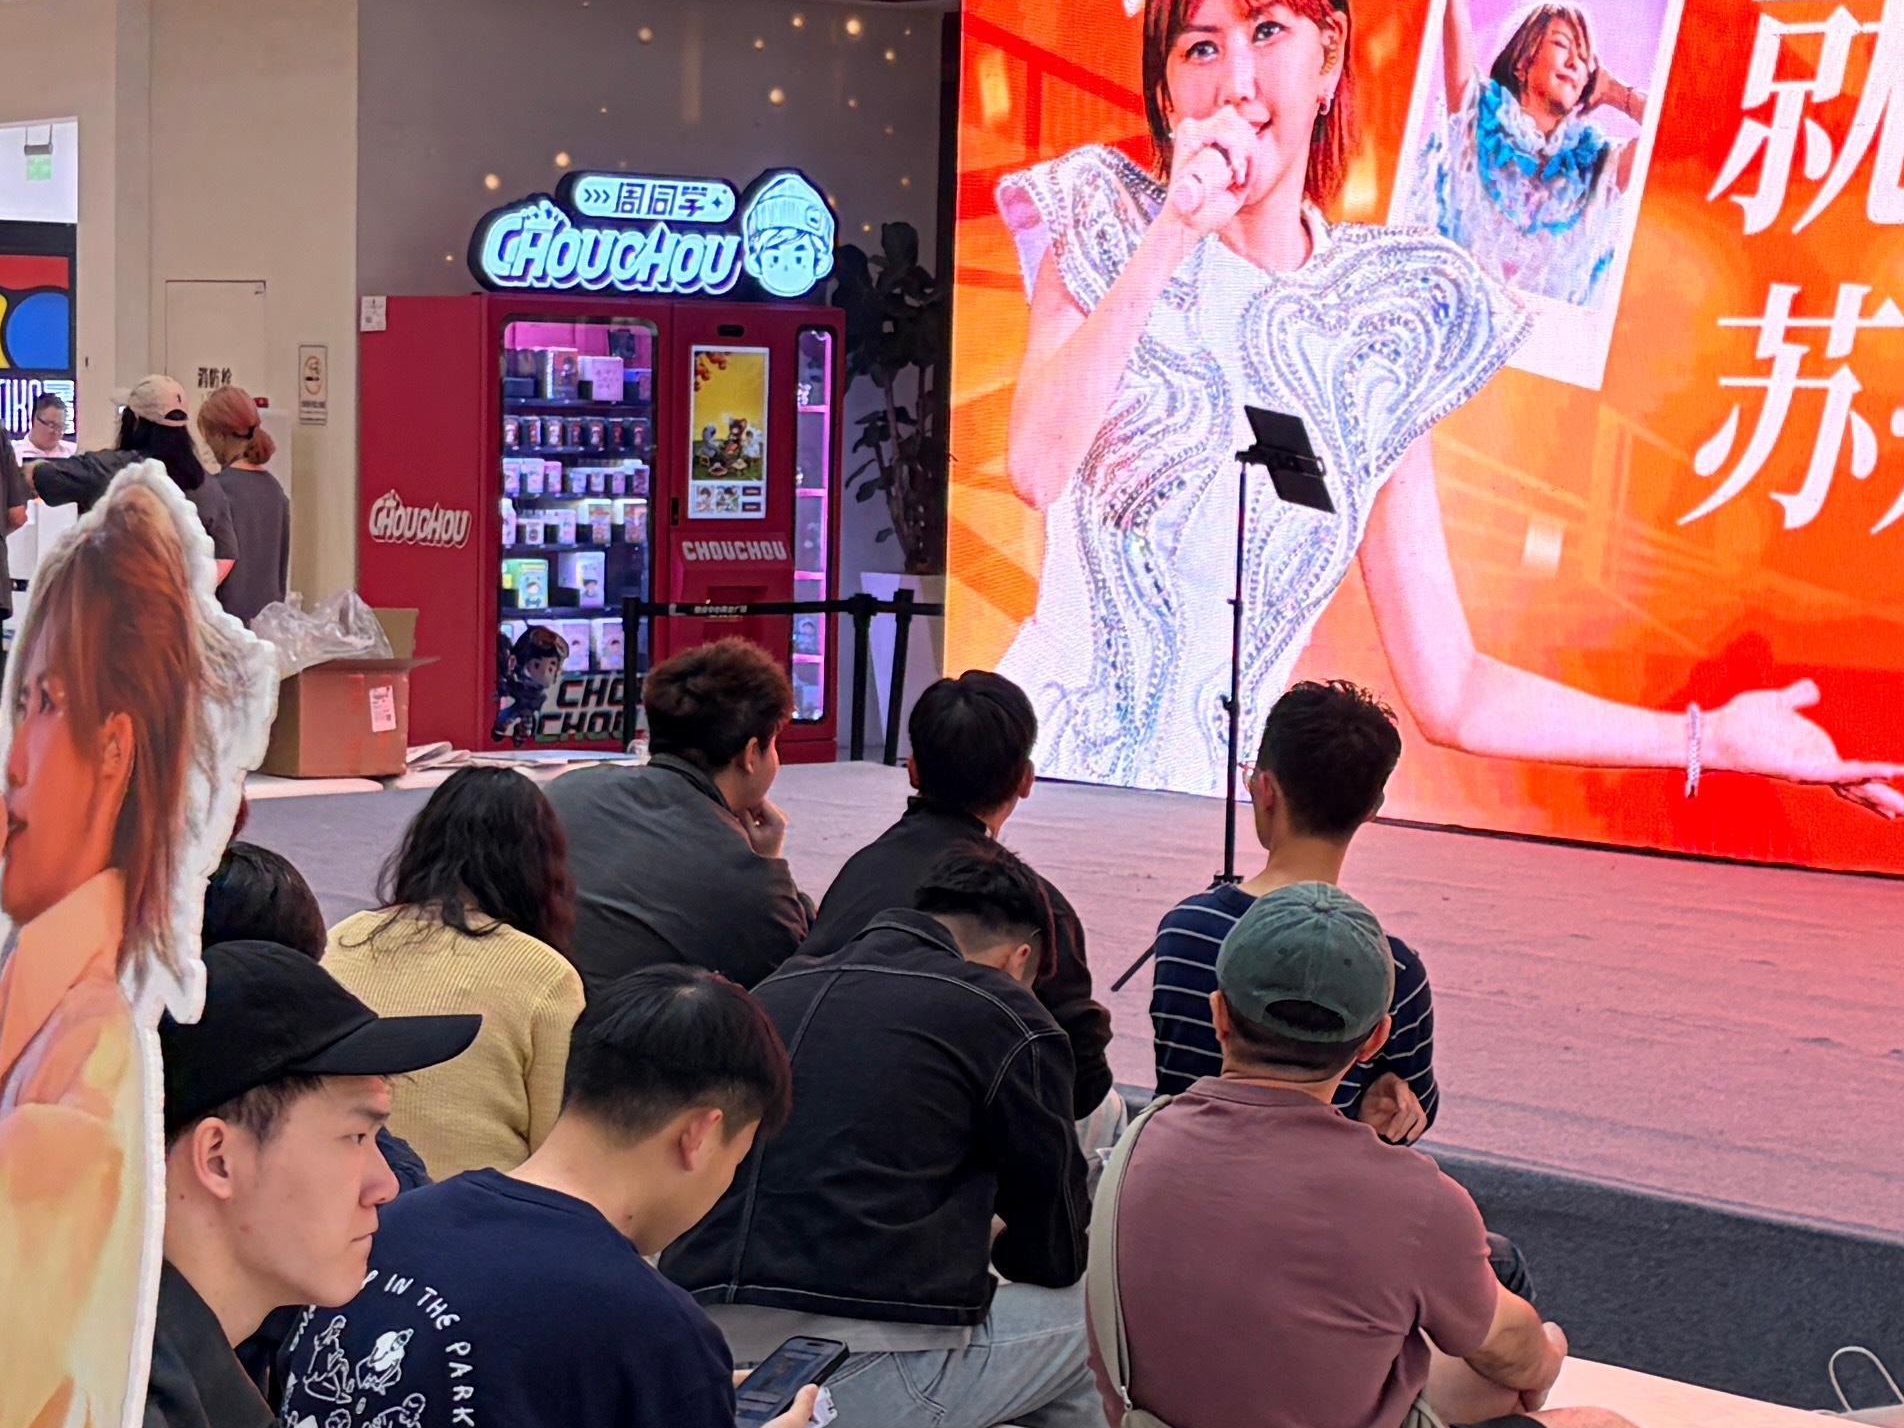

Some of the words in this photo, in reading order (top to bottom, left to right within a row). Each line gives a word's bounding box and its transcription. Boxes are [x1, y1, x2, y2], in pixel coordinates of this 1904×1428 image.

[612, 181, 709, 218] 周同学
[482, 206, 743, 295] CHOUCHOU
[368, 490, 473, 549] CHOUCHOU
[681, 540, 788, 562] CHOUCHOU
[383, 1273, 414, 1295] IN
[416, 1286, 461, 1331] THE
[445, 1341, 475, 1428] PARK
